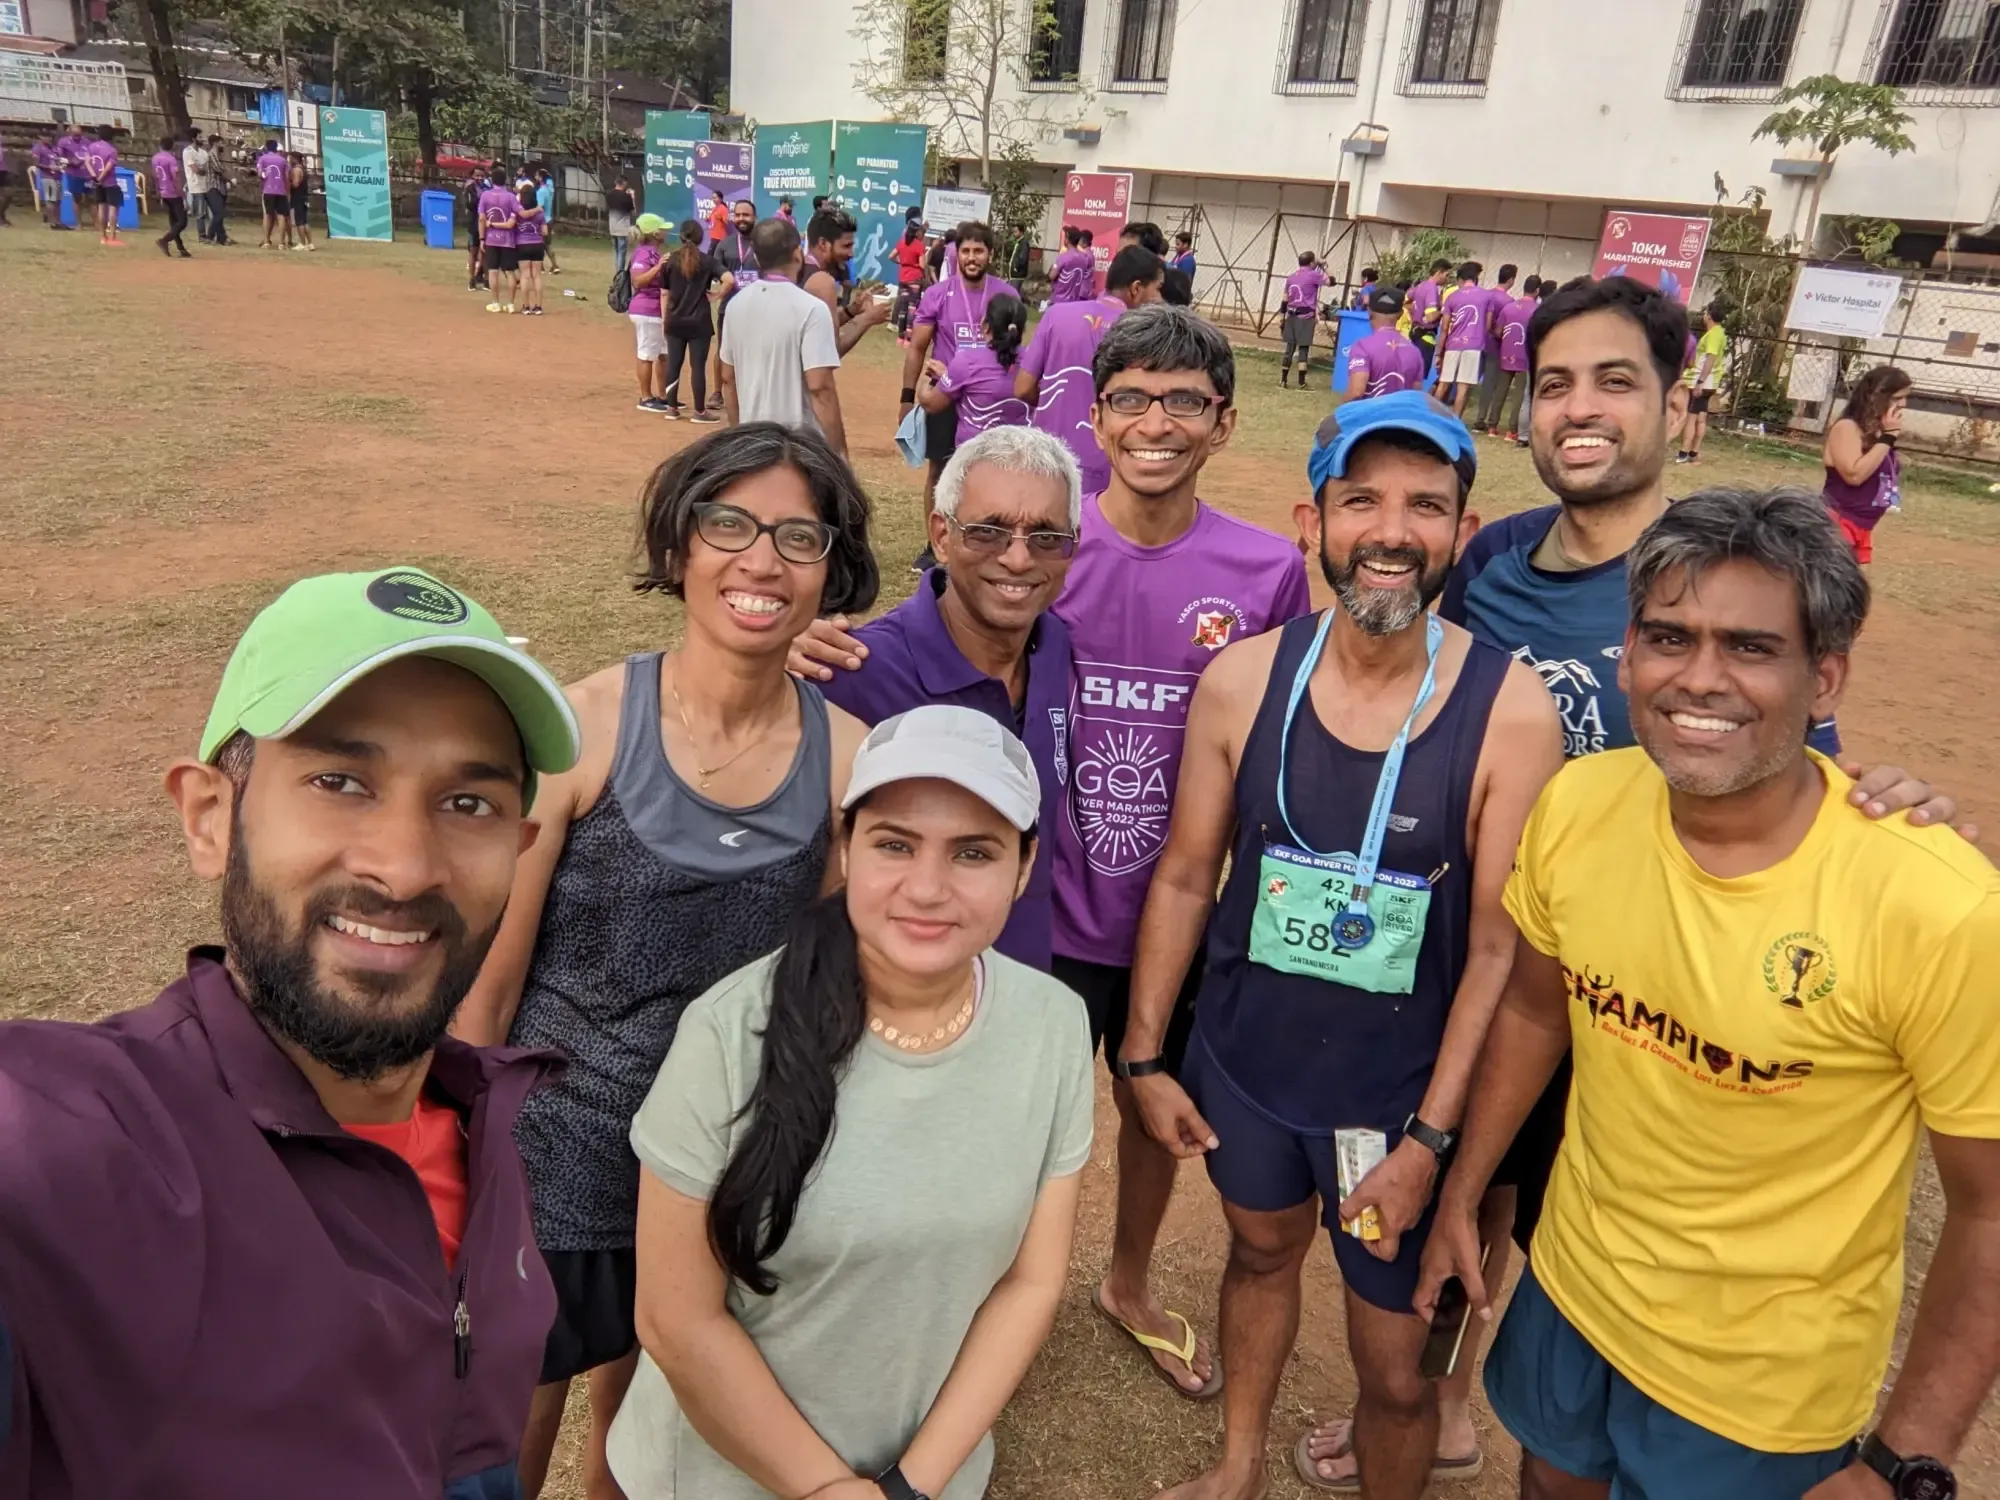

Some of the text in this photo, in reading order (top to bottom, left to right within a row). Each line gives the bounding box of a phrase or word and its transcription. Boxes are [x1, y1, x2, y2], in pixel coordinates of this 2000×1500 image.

[342, 128, 365, 138] FULL
[772, 140, 811, 158] myfitgene
[341, 165, 372, 175] I DID IT
[712, 164, 734, 173] HALF
[857, 157, 899, 170] KEY PARAMETERS
[697, 171, 749, 181] MARATHON FINISHER
[769, 167, 811, 177] DISCOVER YOUR
[328, 174, 385, 187] ONCE AGAIN!
[763, 176, 817, 189] TRUE POTENTIAL
[1084, 198, 1107, 210] 10KM
[1067, 209, 1123, 219] MARATHON FINISHER
[1631, 241, 1667, 257] 10KM
[1603, 252, 1692, 269] MARATHON FINISHER
[1815, 292, 1882, 309] Victor Hospital
[1177, 597, 1247, 631] VASCO SPORTS CLUB
[1081, 676, 1189, 712] SKF
[1075, 760, 1168, 800] GOA
[1076, 796, 1168, 814] IVER MARATHON
[1105, 812, 1134, 824] 2022
[1273, 848, 1292, 859] SKF
[1292, 855, 1312, 866] GOA
[1313, 860, 1342, 872] RIVER
[1393, 878, 1417, 889] 2022
[1386, 912, 1413, 925] GOA
[1385, 921, 1413, 933] RIVER
